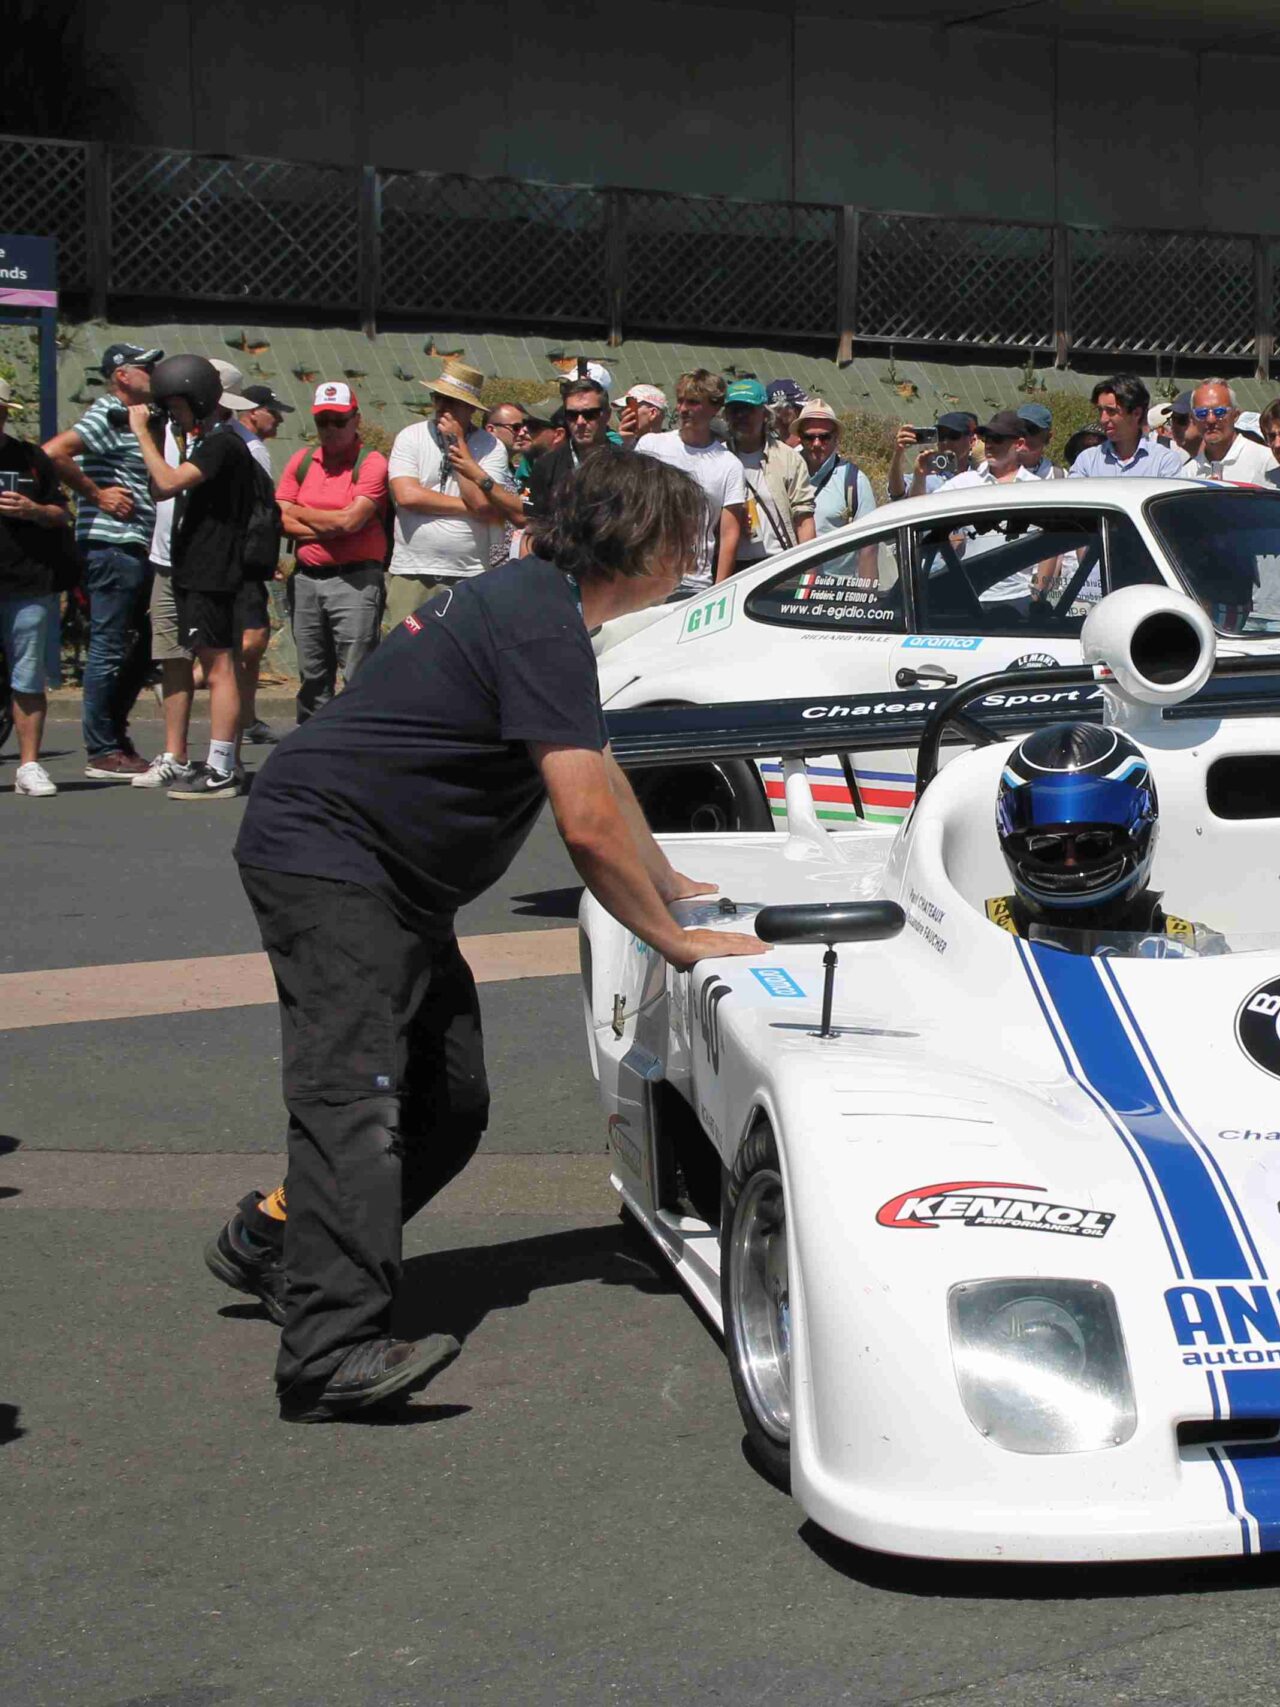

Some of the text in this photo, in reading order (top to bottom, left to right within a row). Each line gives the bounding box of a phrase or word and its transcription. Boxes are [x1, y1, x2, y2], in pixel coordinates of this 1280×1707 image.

[814, 575, 835, 587] Guido
[836, 577, 845, 587] DI
[846, 578, 871, 589] EGIDIO
[835, 591, 844, 601] DI
[844, 591, 868, 603] EGIDIO
[687, 597, 727, 633] GT1
[780, 604, 895, 621] www.di-egidio.com
[855, 635, 894, 643] MILLE
[910, 637, 975, 648] aramco
[982, 691, 1079, 708] Sport
[894, 1196, 1109, 1231] KENNOL
[973, 1216, 1106, 1238] PERFORMANCE OIL
